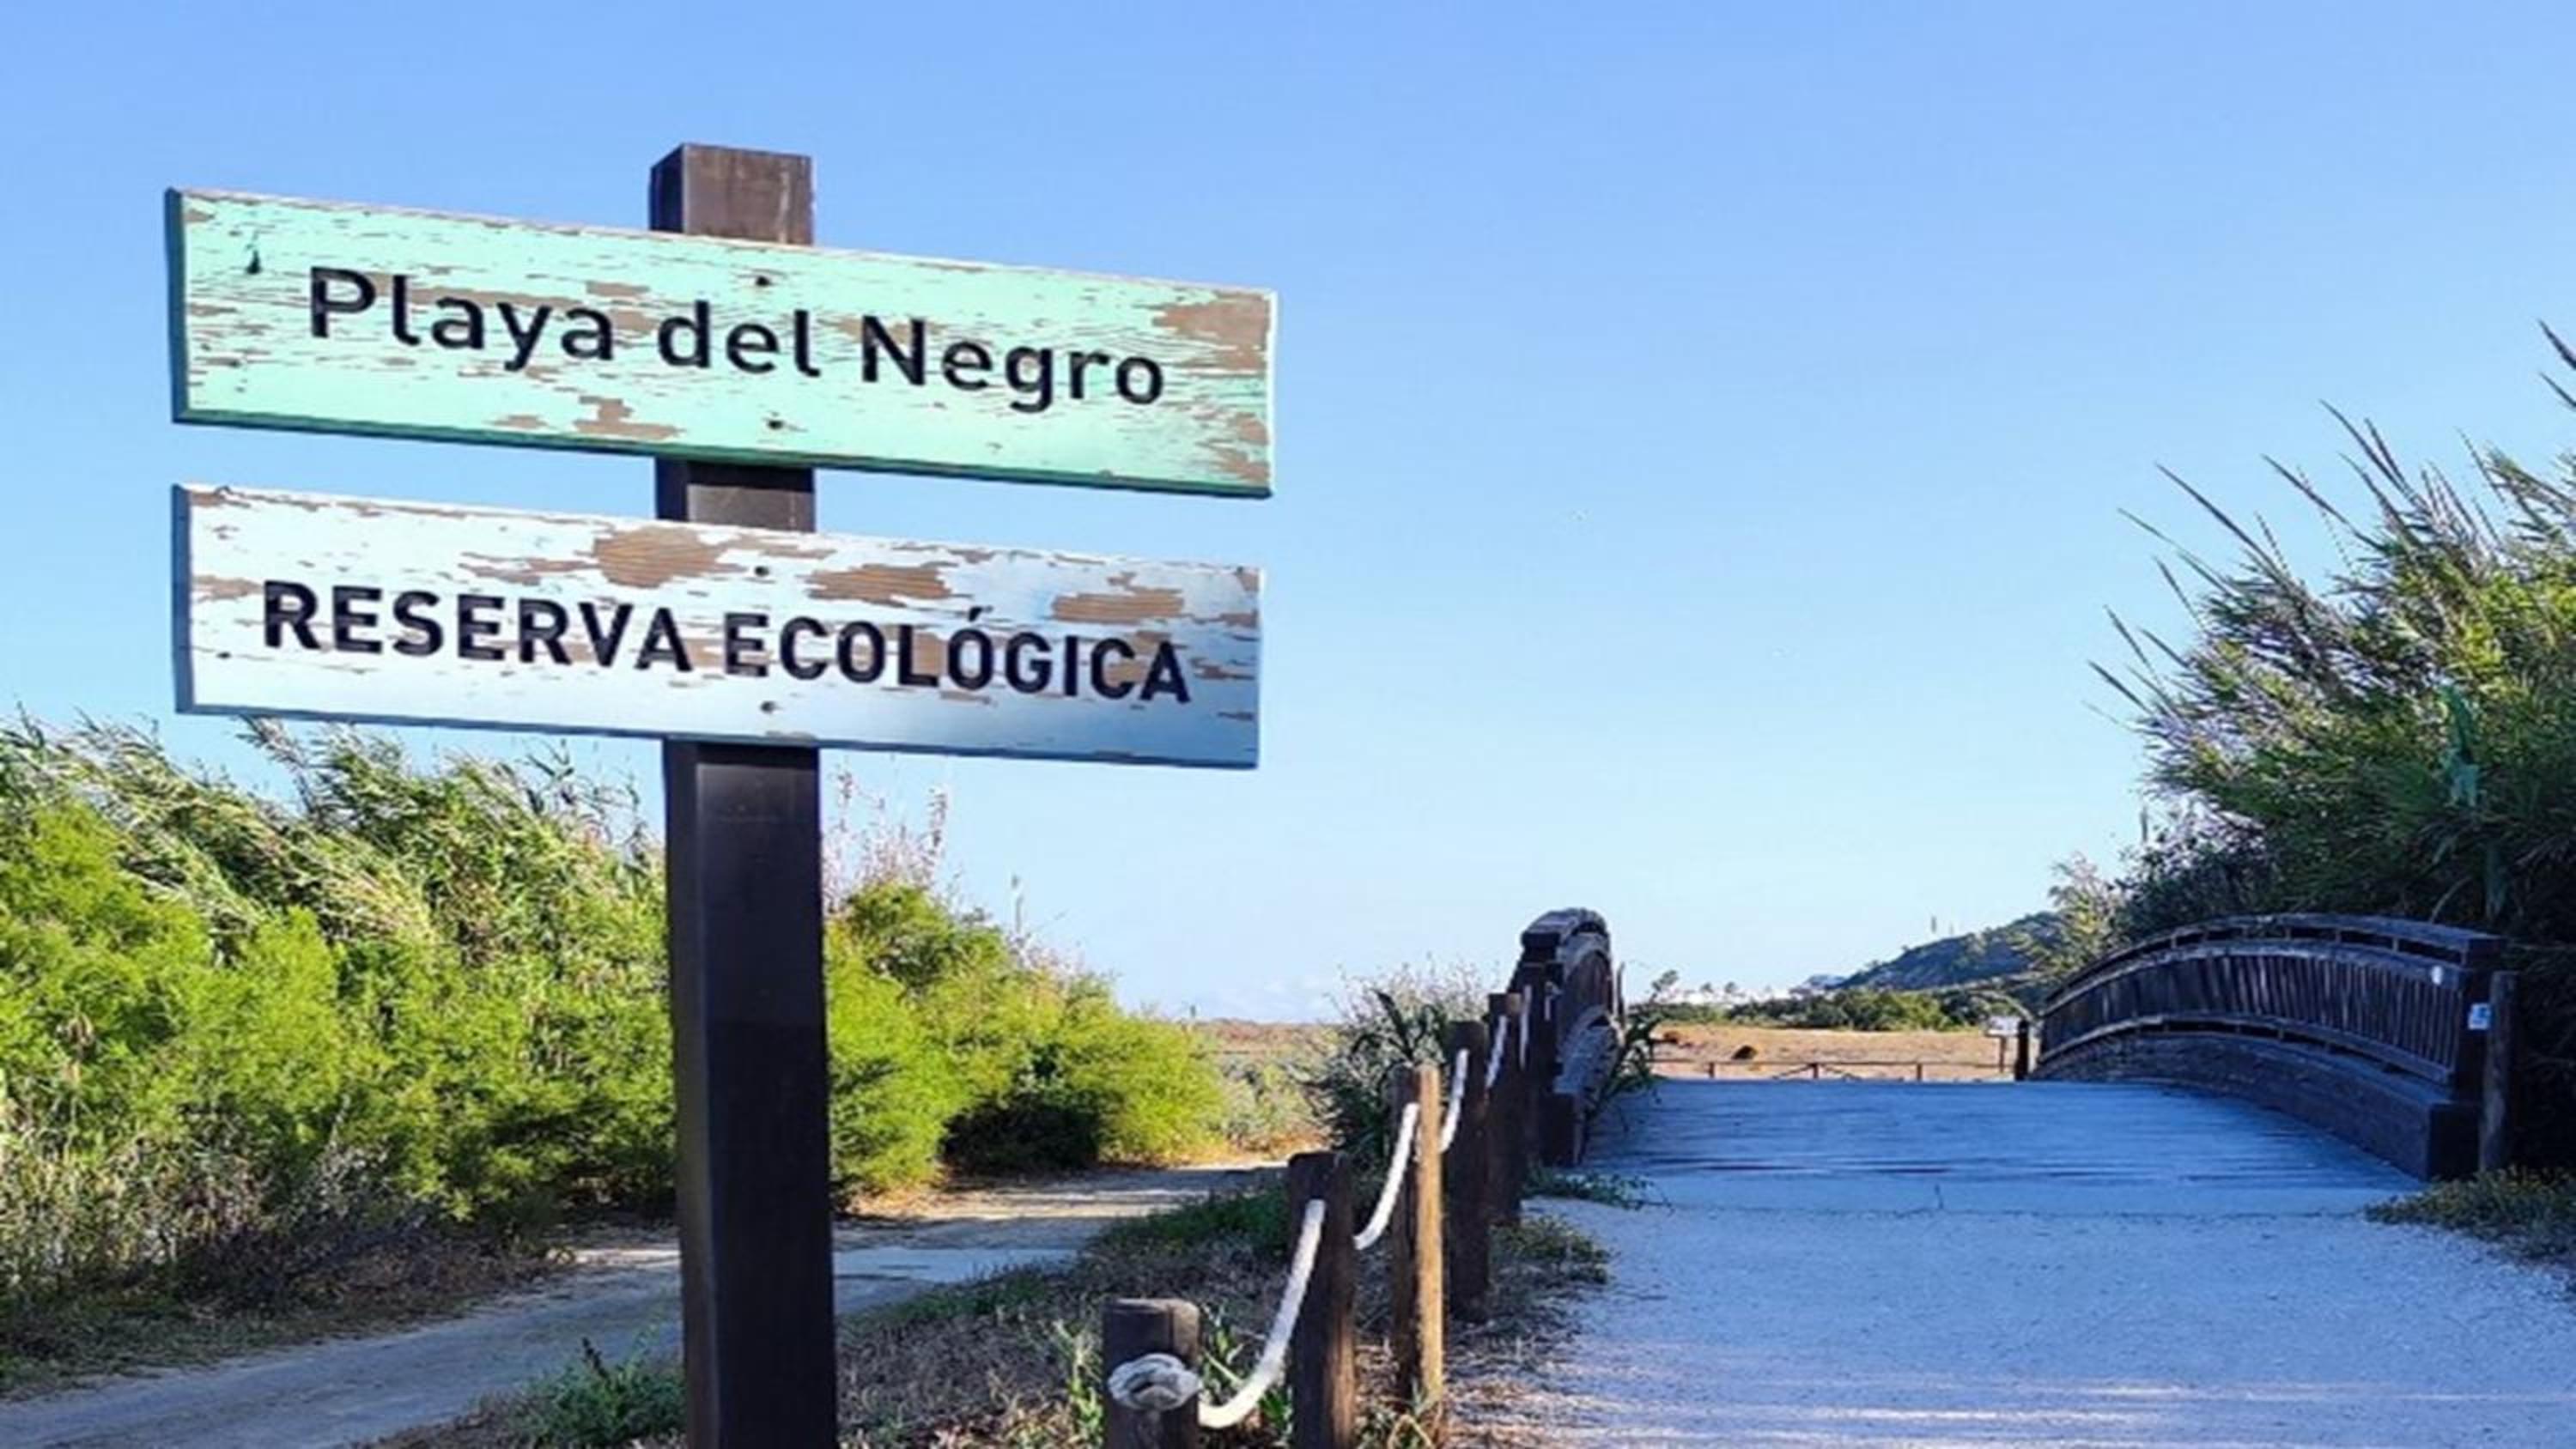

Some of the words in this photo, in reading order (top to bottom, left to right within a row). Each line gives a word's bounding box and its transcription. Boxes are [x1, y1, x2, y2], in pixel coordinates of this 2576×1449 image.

[309, 265, 613, 373] Playa
[657, 300, 821, 379] del
[860, 314, 1165, 414] Negro
[262, 579, 693, 673] RESERVA
[724, 606, 1191, 705] ECOLÓGICA
